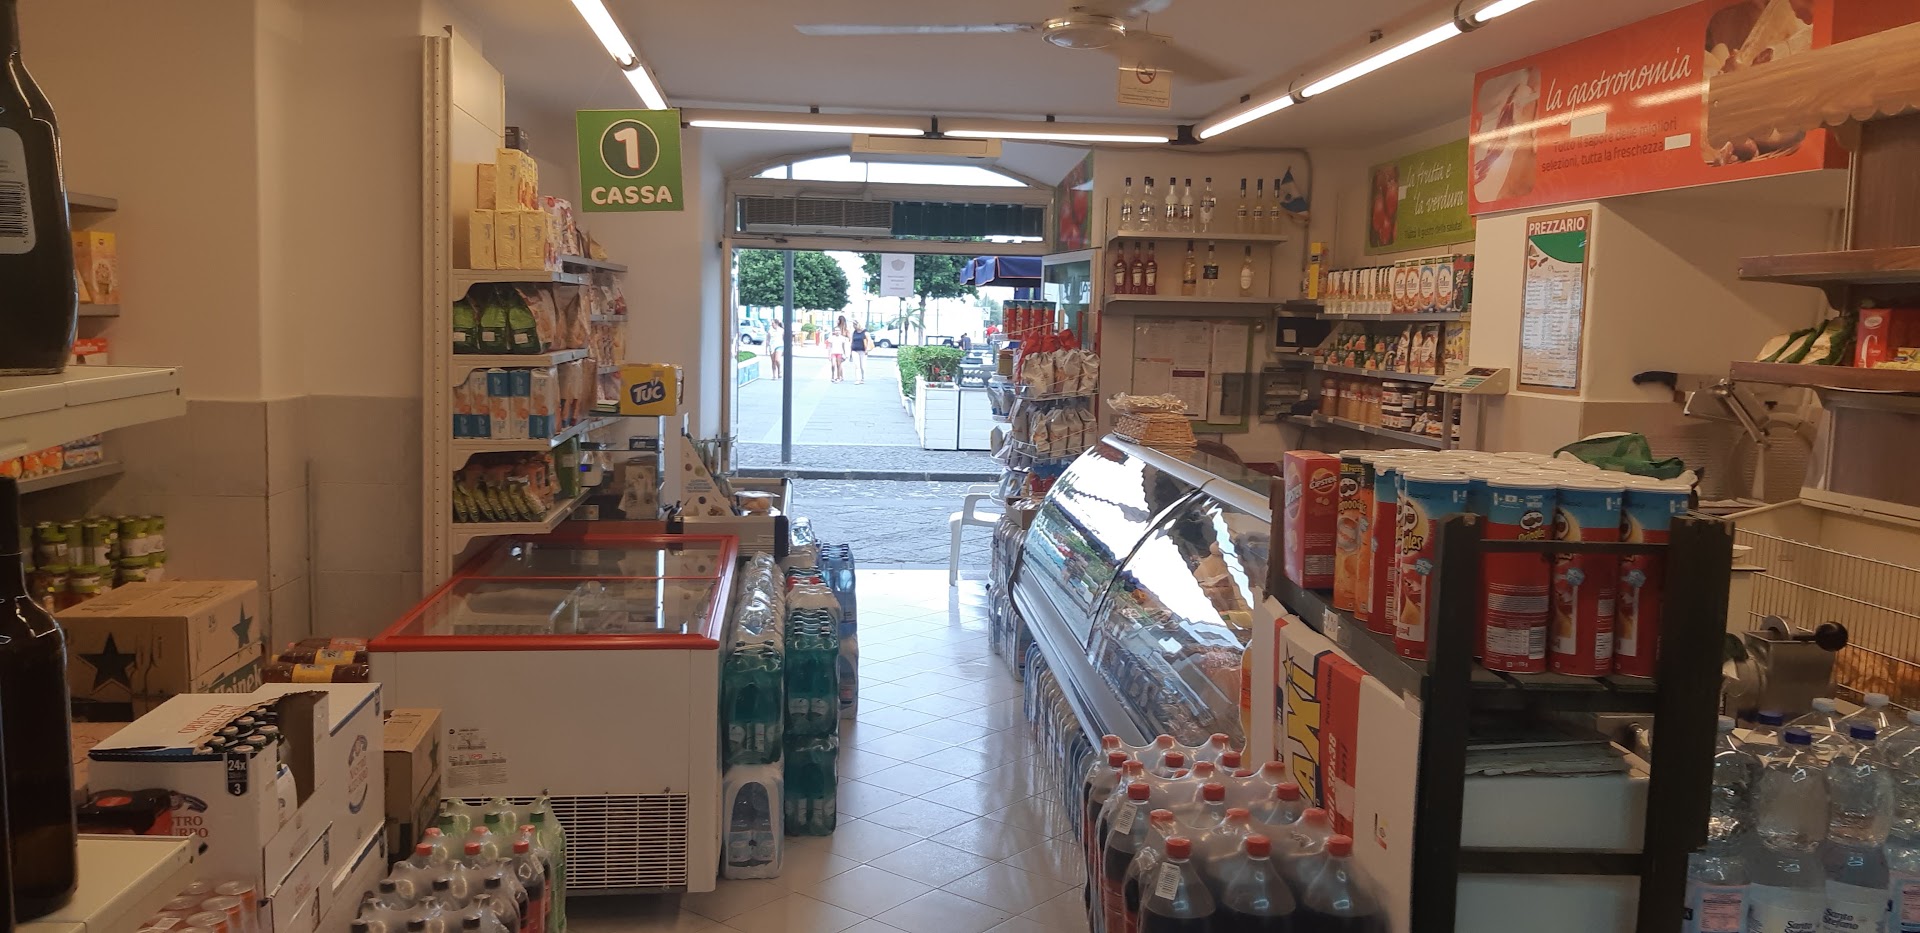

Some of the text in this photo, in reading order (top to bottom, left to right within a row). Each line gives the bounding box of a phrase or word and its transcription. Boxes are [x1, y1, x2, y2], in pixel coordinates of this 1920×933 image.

[1545, 47, 1692, 126] la gastronomia
[1584, 134, 1613, 149] sapore
[1639, 116, 1678, 138] migliori
[614, 127, 639, 170] 1
[1581, 151, 1603, 165] tutta
[1603, 149, 1612, 161] la
[1613, 140, 1664, 160] freschezza
[1414, 161, 1444, 200] frutta
[1445, 163, 1452, 179] e
[590, 184, 673, 206] CASSA
[1414, 184, 1464, 215] la verdura
[1528, 216, 1586, 236] PREZZARIO
[228, 759, 247, 771] 24x
[234, 783, 242, 795] 3
[170, 815, 203, 826] TRO
[1822, 914, 1859, 931] Stefano
[1825, 907, 1854, 922] Santo
